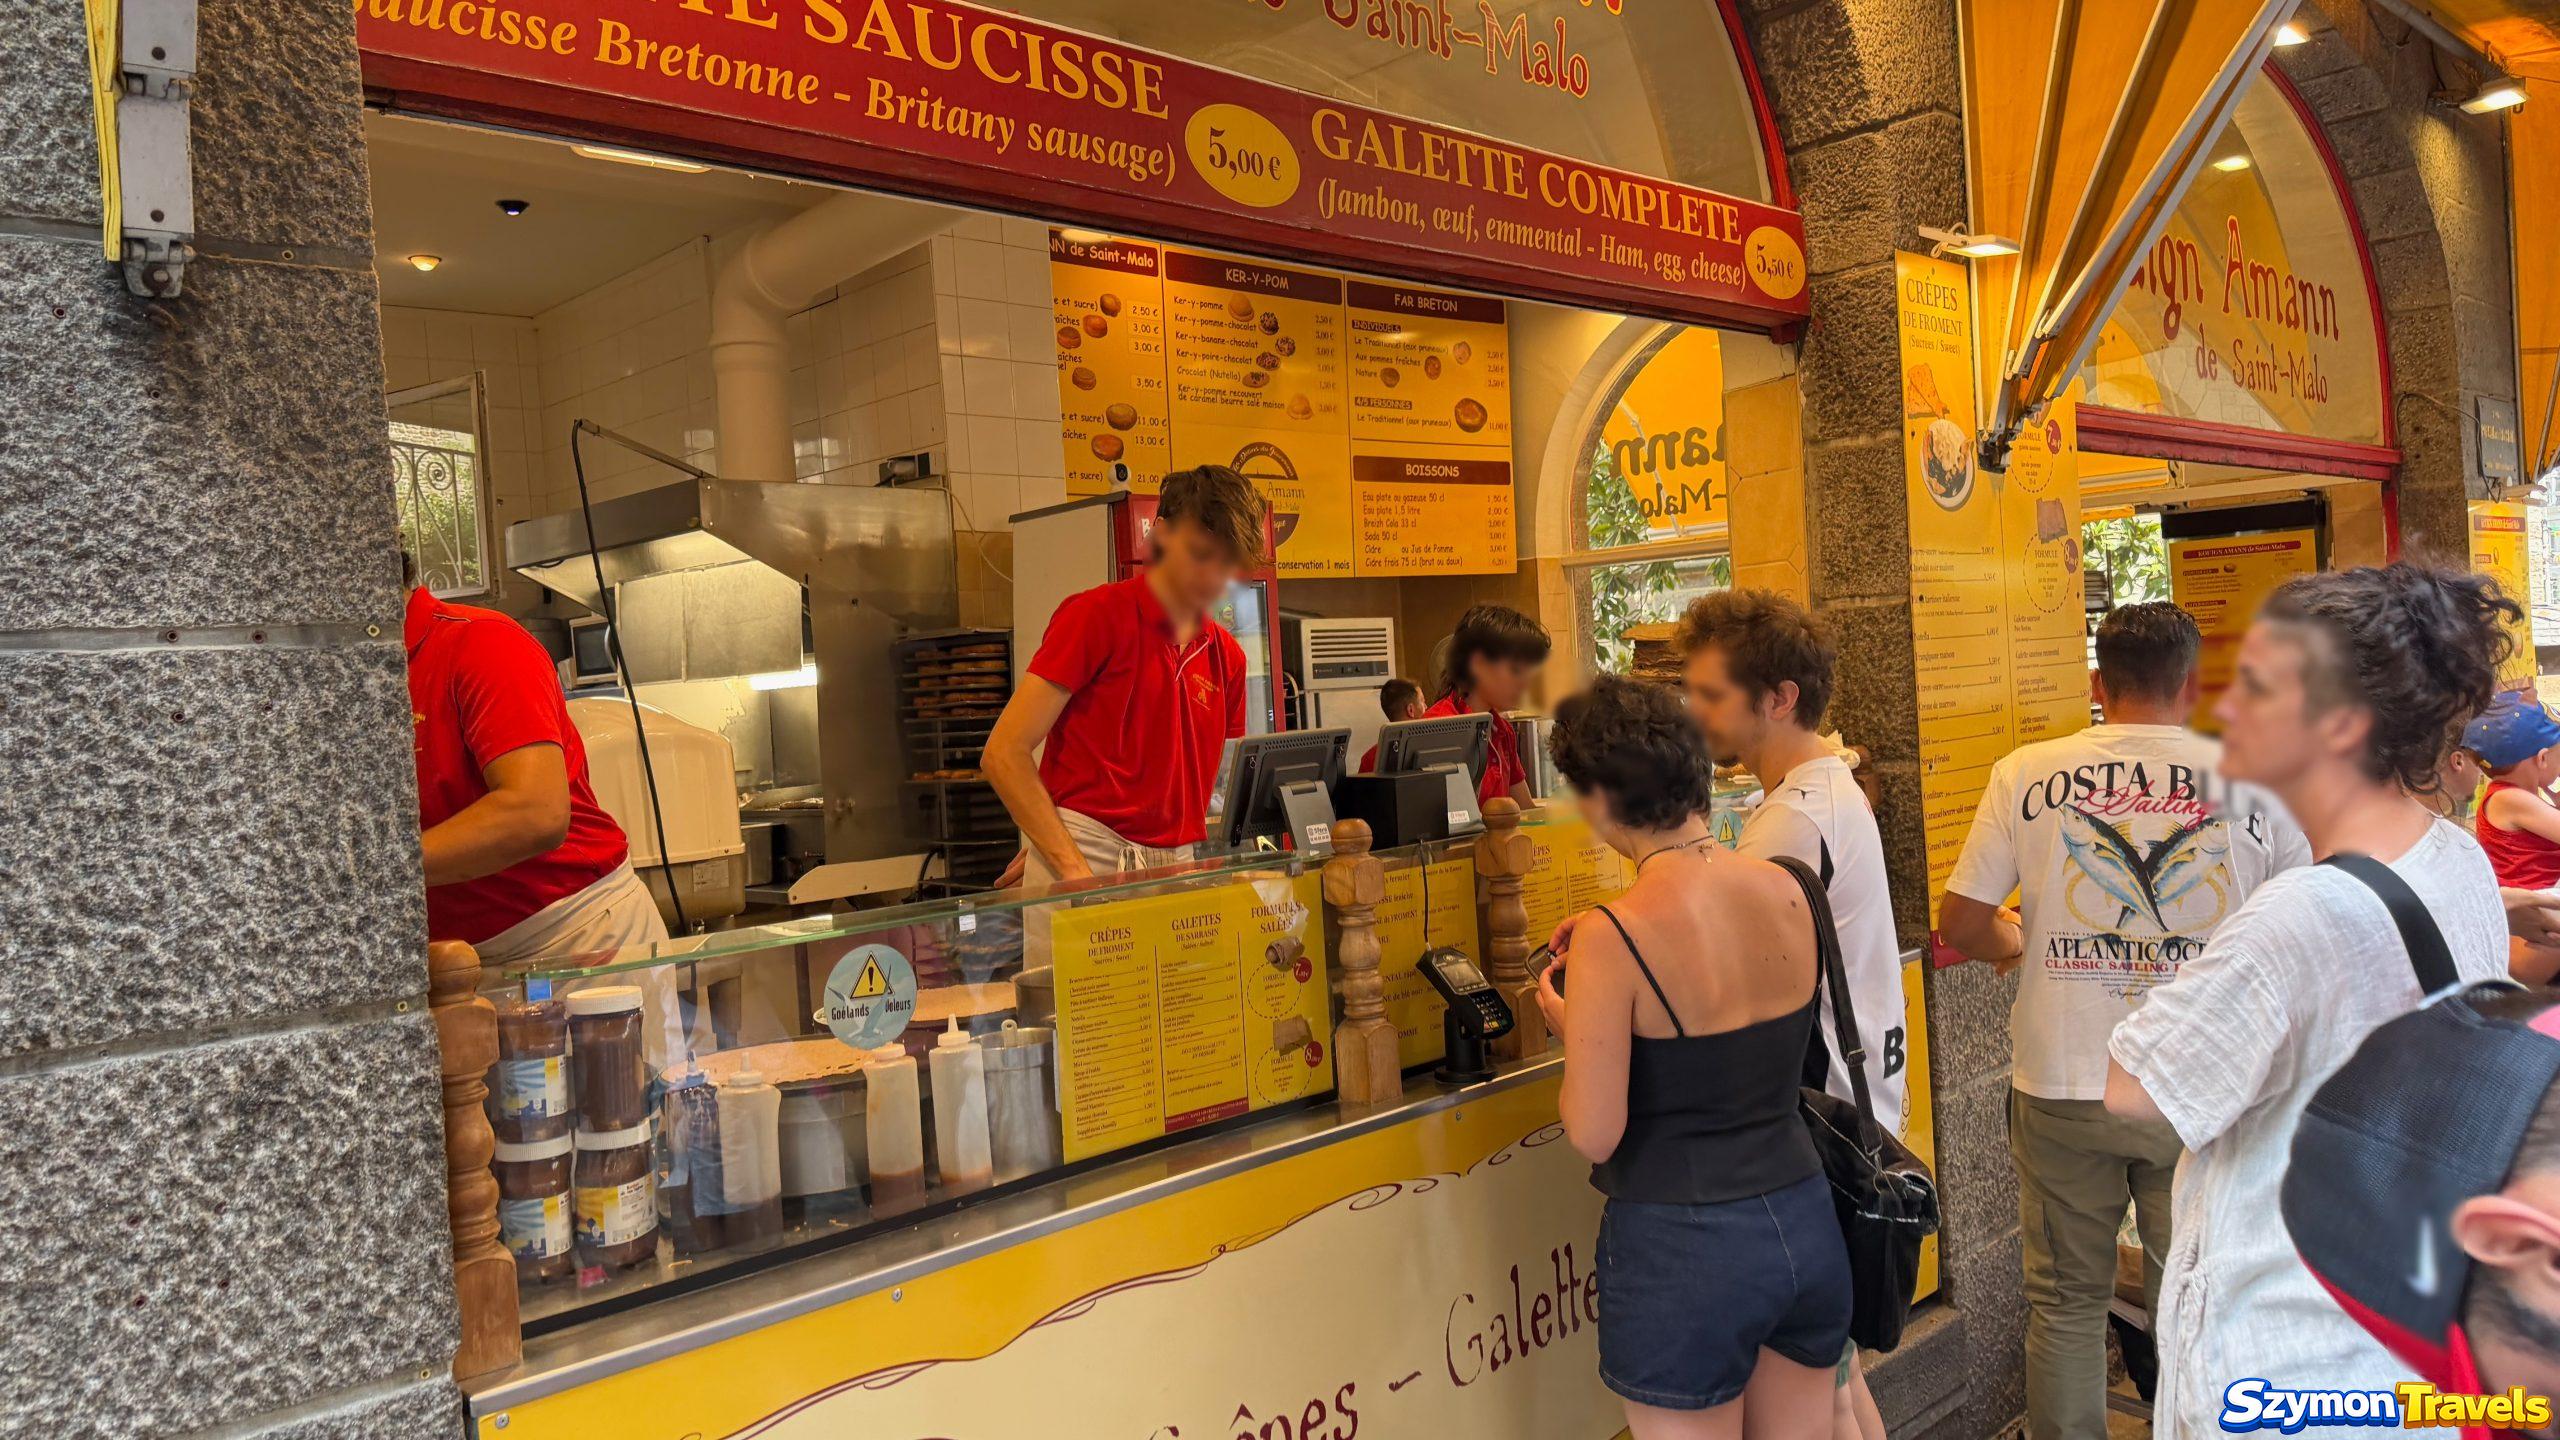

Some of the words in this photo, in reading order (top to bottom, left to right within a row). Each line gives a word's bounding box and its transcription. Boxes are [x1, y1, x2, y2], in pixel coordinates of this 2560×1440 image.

[803, 0, 1169, 121] SAUCISSE
[354, 0, 577, 55] aucisse
[593, 17, 819, 104] Bretonne
[864, 77, 1016, 155] Britany
[1027, 122, 1177, 188] sausage)
[1207, 126, 1265, 179] 5,00
[1268, 156, 1282, 181] €
[1311, 108, 1528, 200] GALETTE
[1538, 163, 1742, 246] COMPLETE
[1317, 176, 1426, 231] (Jambon,
[1485, 213, 1583, 259] emmental
[1599, 233, 1651, 276] Ham,
[1653, 249, 1687, 285] egg,
[1691, 252, 1748, 294] cheese)
[1070, 242, 1085, 257] de
[1089, 246, 1154, 268] Saint-Malo
[1754, 244, 1785, 281] 5,50
[1786, 260, 1796, 280] €
[1225, 267, 1290, 290] KER-Y-POM
[2128, 234, 2204, 341] ign
[2222, 214, 2340, 341] Amann
[1906, 275, 1958, 312] CRÊPES
[1062, 298, 1070, 306] et
[1074, 300, 1098, 312] sucre)
[1174, 296, 1224, 311] Ker-y-pomme
[1394, 293, 1414, 308] FAR
[1417, 296, 1458, 312] BRETON
[1152, 309, 1158, 317] €
[1055, 315, 1080, 326] aîches
[1175, 313, 1257, 332] Ker-y-pomme-chocolat
[1903, 310, 1918, 329] DE
[1919, 313, 1963, 337] FROMENT
[1133, 324, 1151, 333] 3,00
[1154, 326, 1159, 334] €
[1134, 342, 1152, 352] 3,00
[1154, 344, 1160, 352] €
[1176, 331, 1258, 349] Ker-y-banane-chocolat
[1176, 349, 1253, 365] Ker-y-poire-chocolat
[1355, 353, 1367, 361] Aux
[1370, 355, 1392, 364] pommes
[1395, 356, 1421, 367] fraîches
[2195, 323, 2218, 382] de
[2232, 337, 2328, 405] Saint-Malo
[1210, 369, 1241, 381] (Nutella)
[1355, 369, 1378, 378] Nature
[1136, 378, 1154, 388] 3,50
[1157, 380, 1162, 389] €
[1178, 384, 1227, 397] Ker-y-pomme
[1229, 390, 1262, 398] recouvert
[1263, 401, 1285, 409] maison
[1069, 412, 1077, 421] et
[1081, 414, 1105, 425] sucre)
[1162, 418, 1168, 427] €
[1367, 414, 1404, 424] Traditionnel
[1159, 437, 1164, 445] €
[1081, 472, 1103, 481] sucre)
[1406, 463, 1460, 477] BOISSONS
[1362, 492, 1374, 502] Eau
[1376, 492, 1391, 502] plate
[1363, 505, 1375, 515] Eau
[1377, 506, 1392, 516] plate
[1364, 519, 1384, 528] Breizh
[1386, 519, 1399, 528] Cola
[1365, 532, 1380, 541] Soda
[1365, 545, 1381, 554] Cidre
[1411, 545, 1421, 553] Jus
[1424, 545, 1432, 553] de
[1434, 545, 1453, 553] Pomme
[1277, 560, 1324, 571] conservation
[1334, 560, 1350, 570] mois
[1365, 558, 1382, 568] Cidre
[1384, 557, 1399, 567] frais
[2021, 761, 2155, 822] COSTA
[1171, 912, 1222, 932] GALETTES
[1089, 926, 1132, 944] CRÊPES
[1101, 940, 1135, 957] FROMENT
[2045, 937, 2159, 962] ATLANTIC
[2045, 959, 2104, 970] CLASSIC
[2109, 960, 2169, 973] SAILING
[830, 1003, 870, 1021] Goélands
[1883, 1025, 1905, 1079] B
